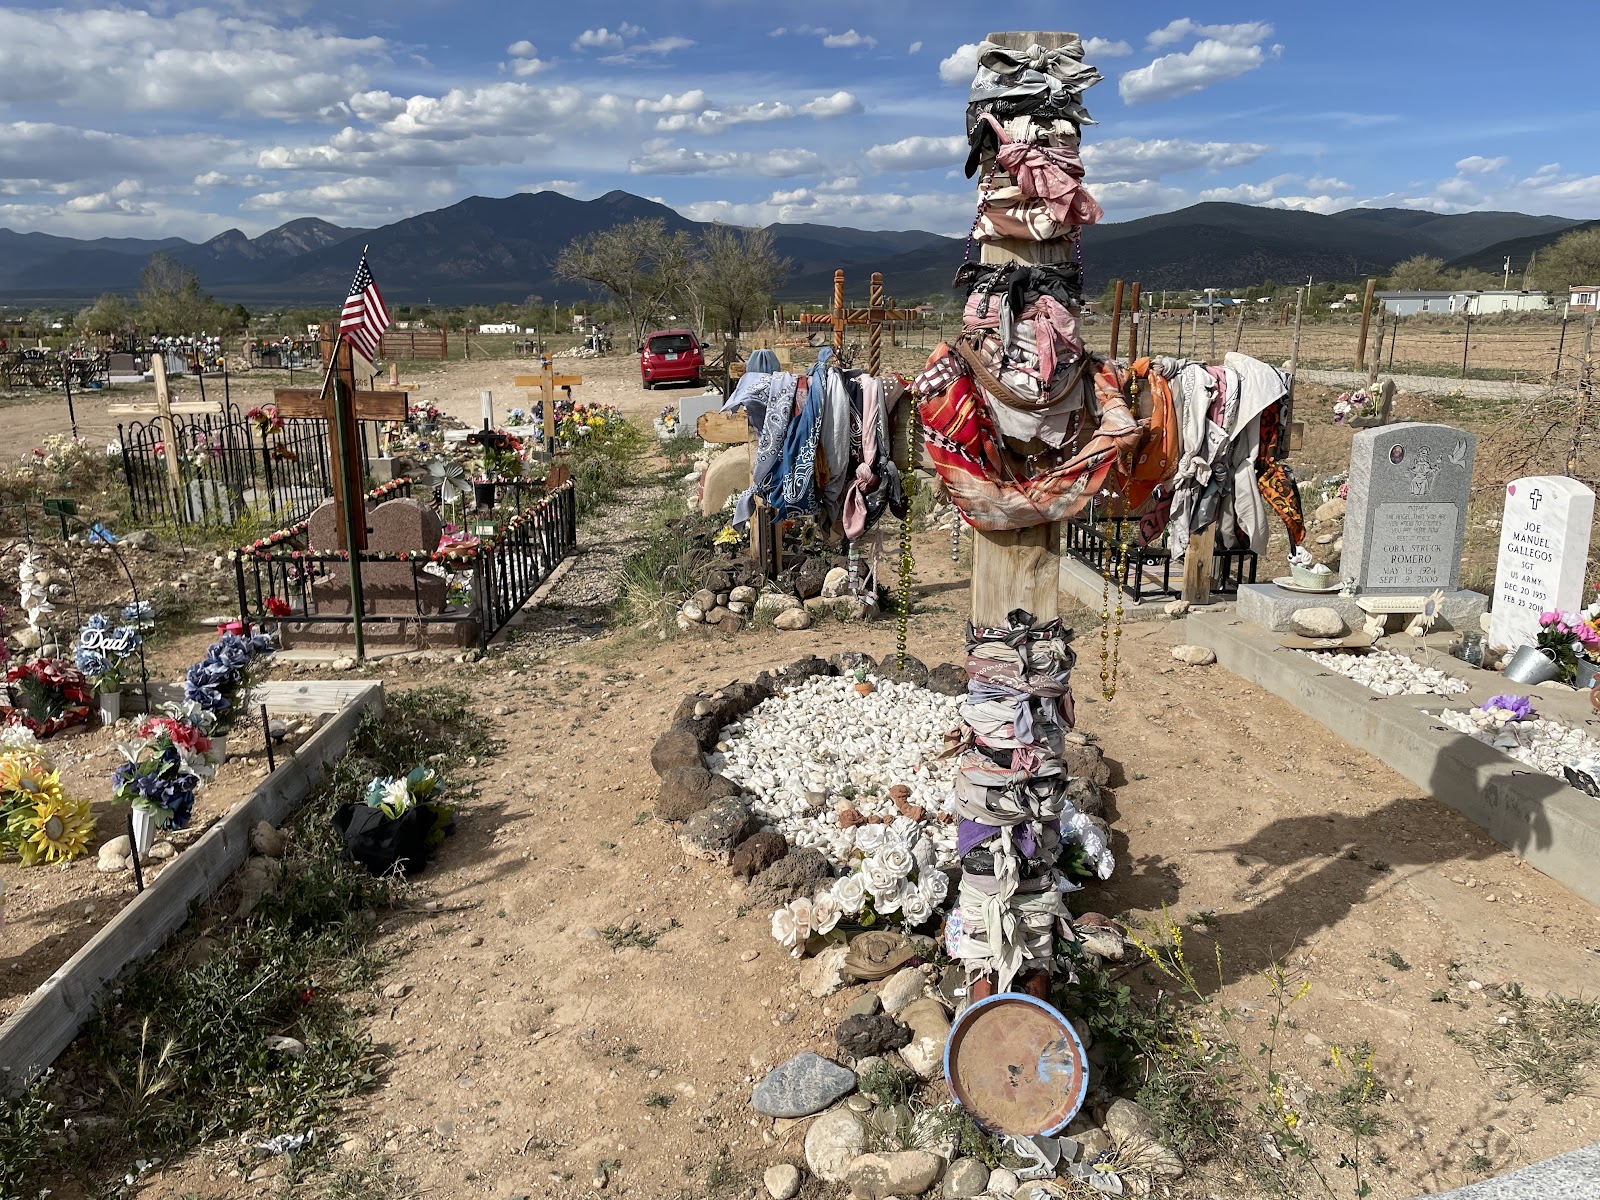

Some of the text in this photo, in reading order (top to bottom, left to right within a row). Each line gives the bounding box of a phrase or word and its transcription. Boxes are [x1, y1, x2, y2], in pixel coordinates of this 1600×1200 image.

[1524, 522, 1541, 533] JOE
[1512, 531, 1550, 549] MANUEL
[1391, 555, 1432, 563] ROMERO
[1507, 543, 1552, 562] GALLEGOS
[1521, 561, 1534, 571] SGT
[1510, 570, 1542, 586] US ARMY
[1504, 581, 1518, 592] DEC
[1520, 586, 1530, 595] 20
[1503, 594, 1515, 604] FEB
[1529, 602, 1544, 614] 2018
[81, 628, 129, 651] Dad
